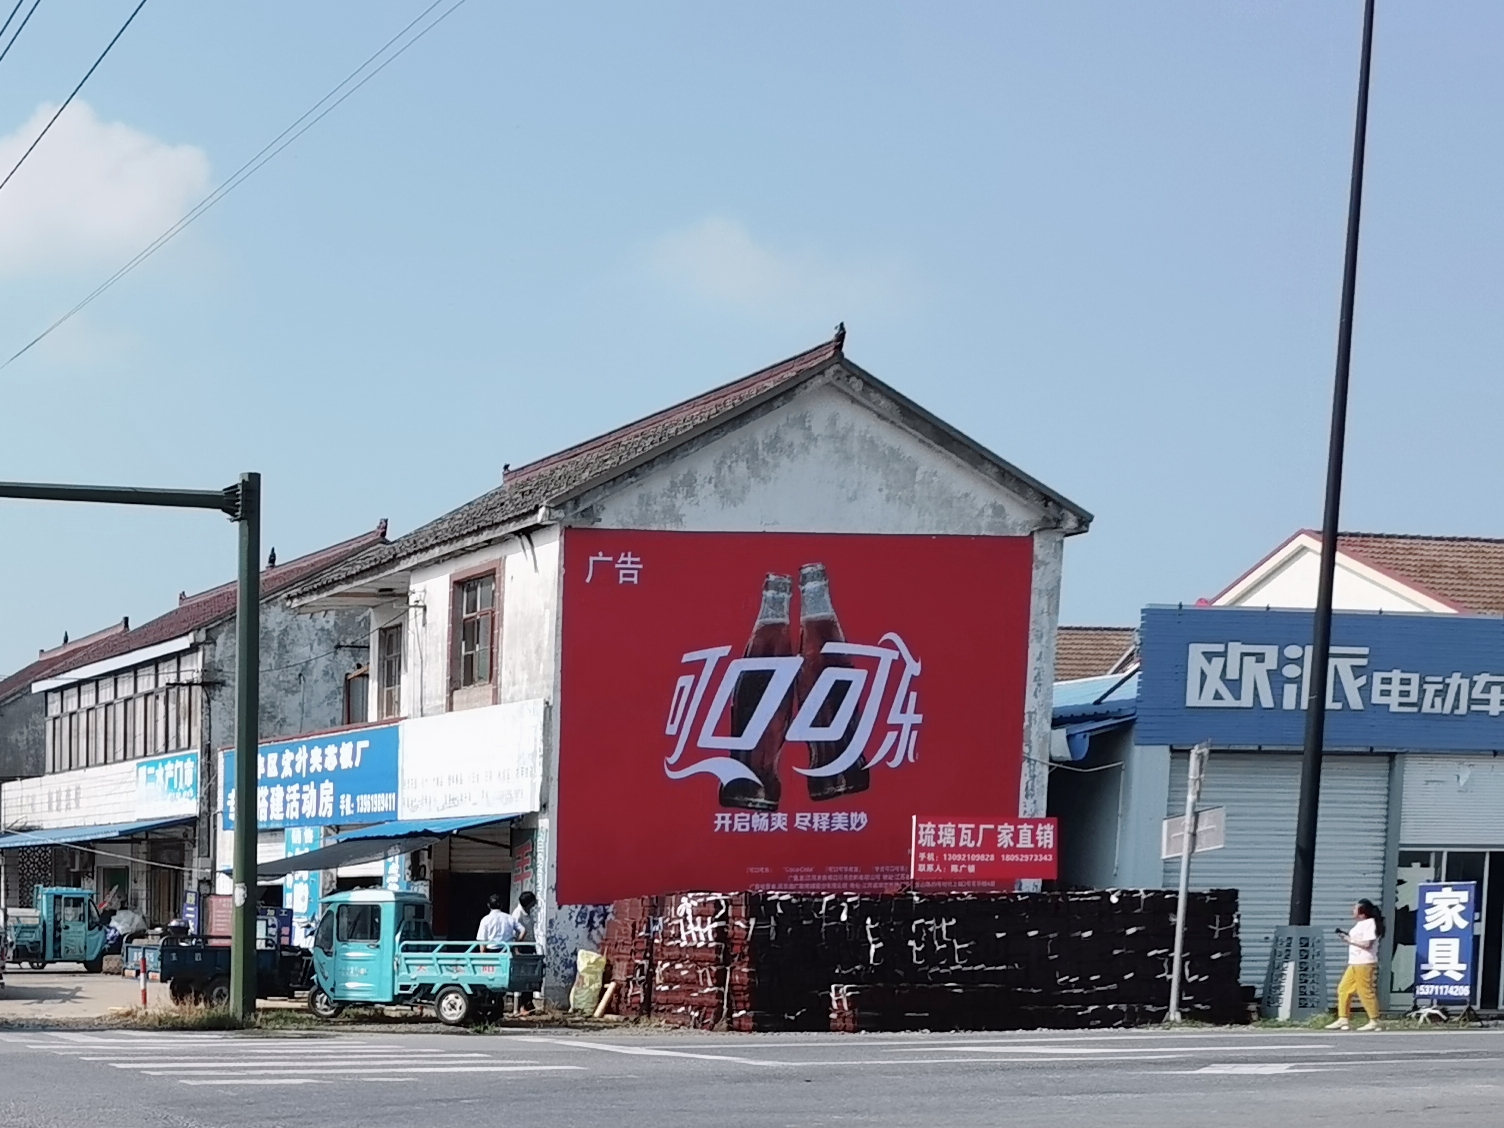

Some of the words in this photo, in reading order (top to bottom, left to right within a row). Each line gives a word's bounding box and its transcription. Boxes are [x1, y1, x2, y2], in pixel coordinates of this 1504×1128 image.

[585, 551, 643, 584] 广告
[664, 632, 923, 787] 可口可乐
[714, 812, 789, 833] 开启畅爽
[793, 811, 869, 832] 尽释美妙
[918, 821, 1055, 849] 琉璃瓦厂家直销
[1420, 887, 1470, 982] 家具
[1416, 985, 1471, 996] 15371174206
